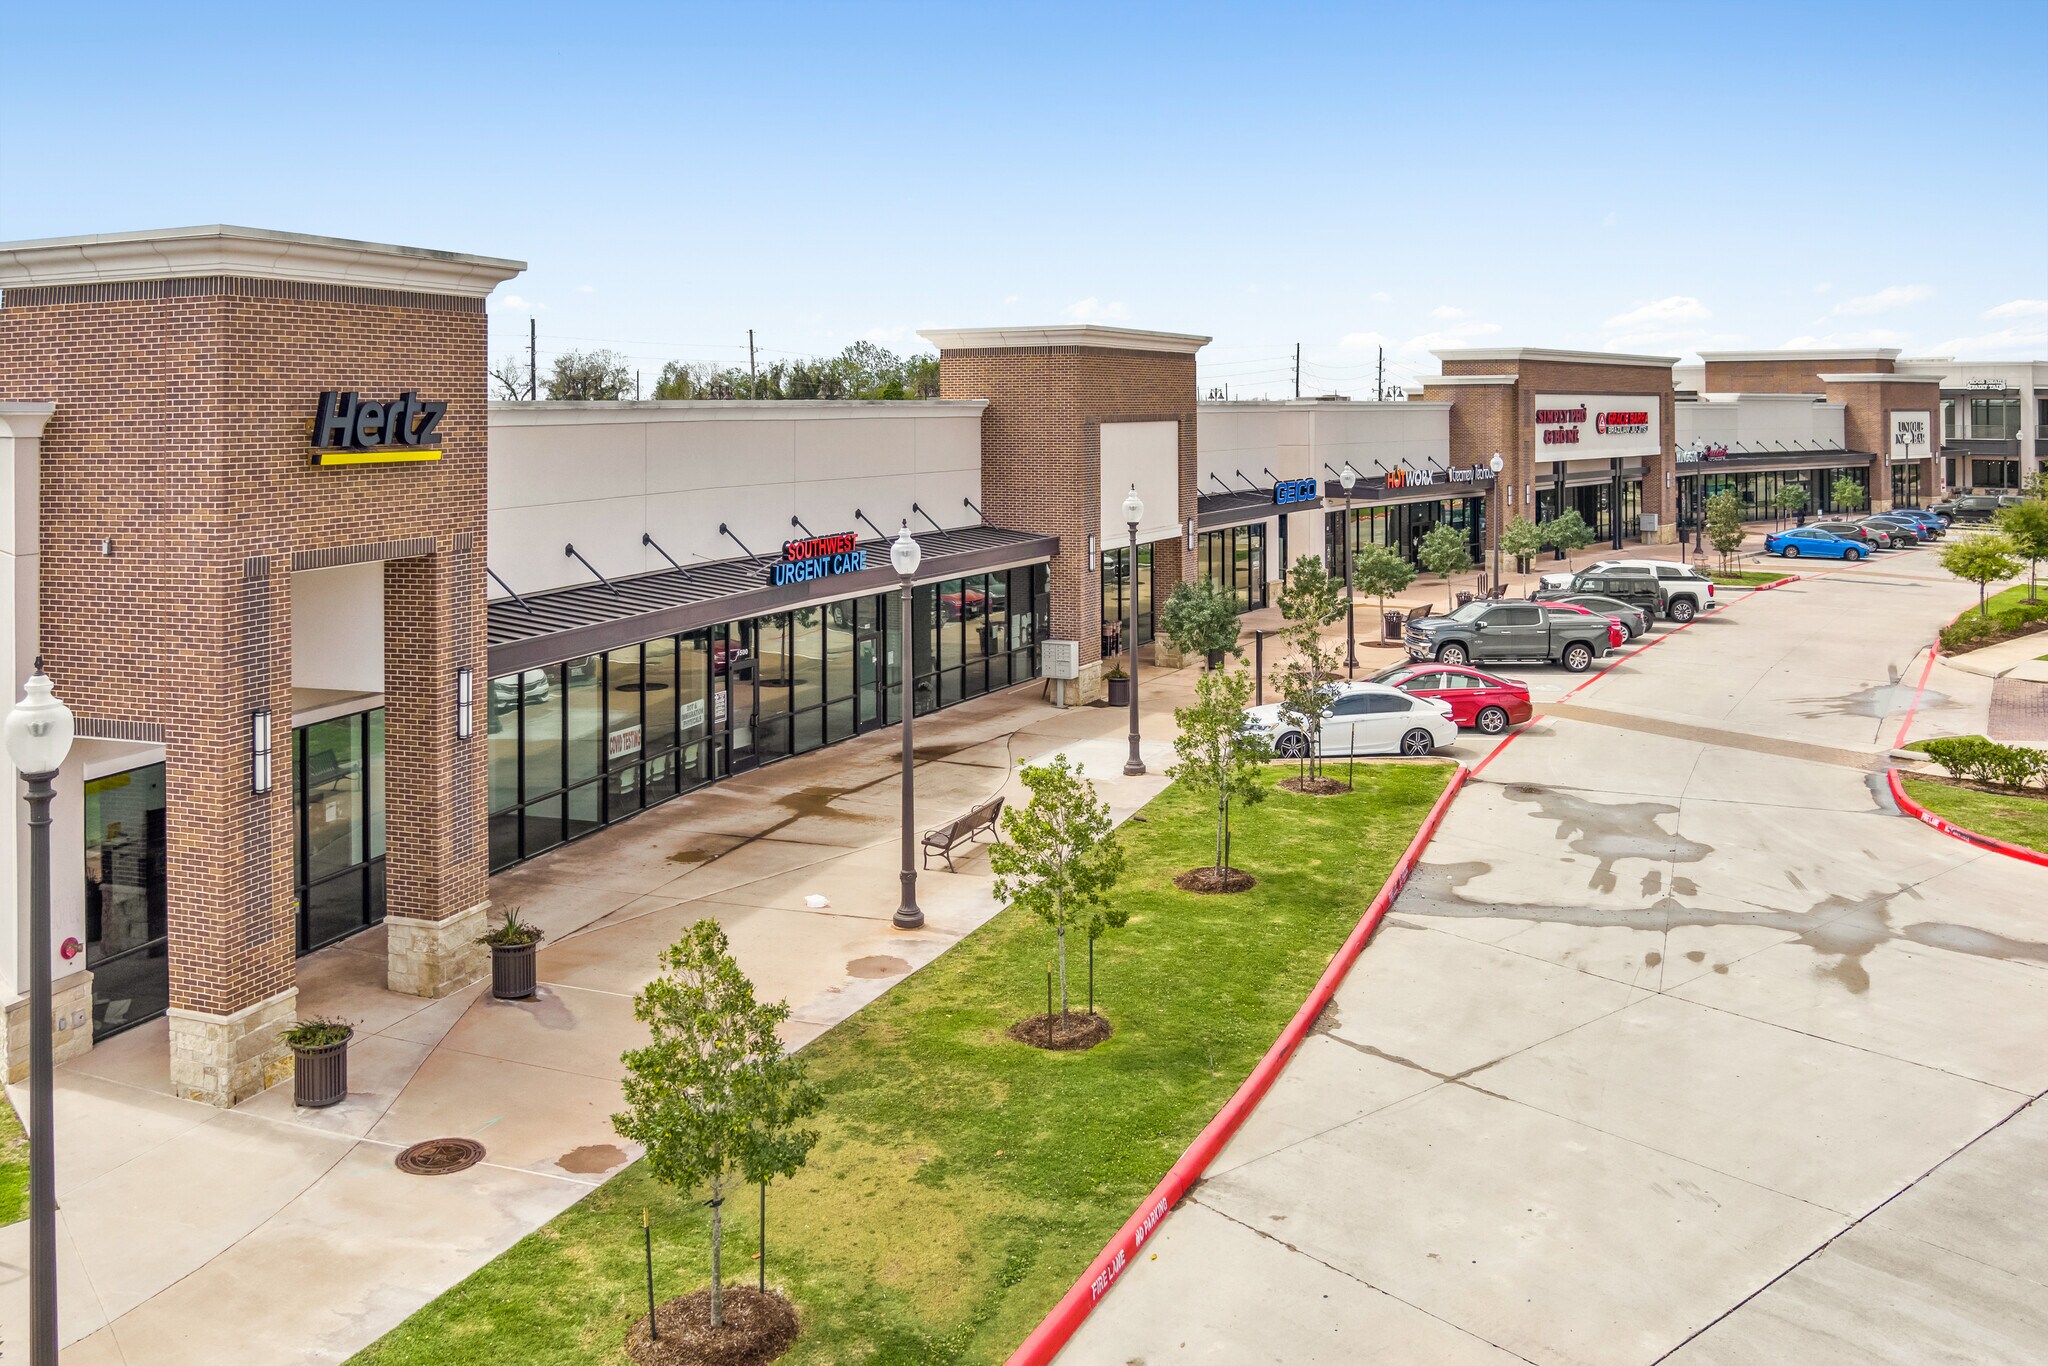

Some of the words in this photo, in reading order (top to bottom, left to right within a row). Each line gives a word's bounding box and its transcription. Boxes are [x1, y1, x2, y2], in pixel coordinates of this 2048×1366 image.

[313, 391, 448, 449] Hertz
[1536, 410, 1568, 424] SIMPLY
[1275, 479, 1317, 505] GEICO
[787, 533, 858, 561] SOUTHWEST
[775, 556, 830, 586] URGENT
[833, 550, 868, 575] CARE
[609, 734, 622, 755] COVID
[1091, 1270, 1108, 1300] FIRE
[1107, 1249, 1126, 1280] LANE
[1135, 1226, 1145, 1247] NO
[1143, 1197, 1168, 1235] PARKING
